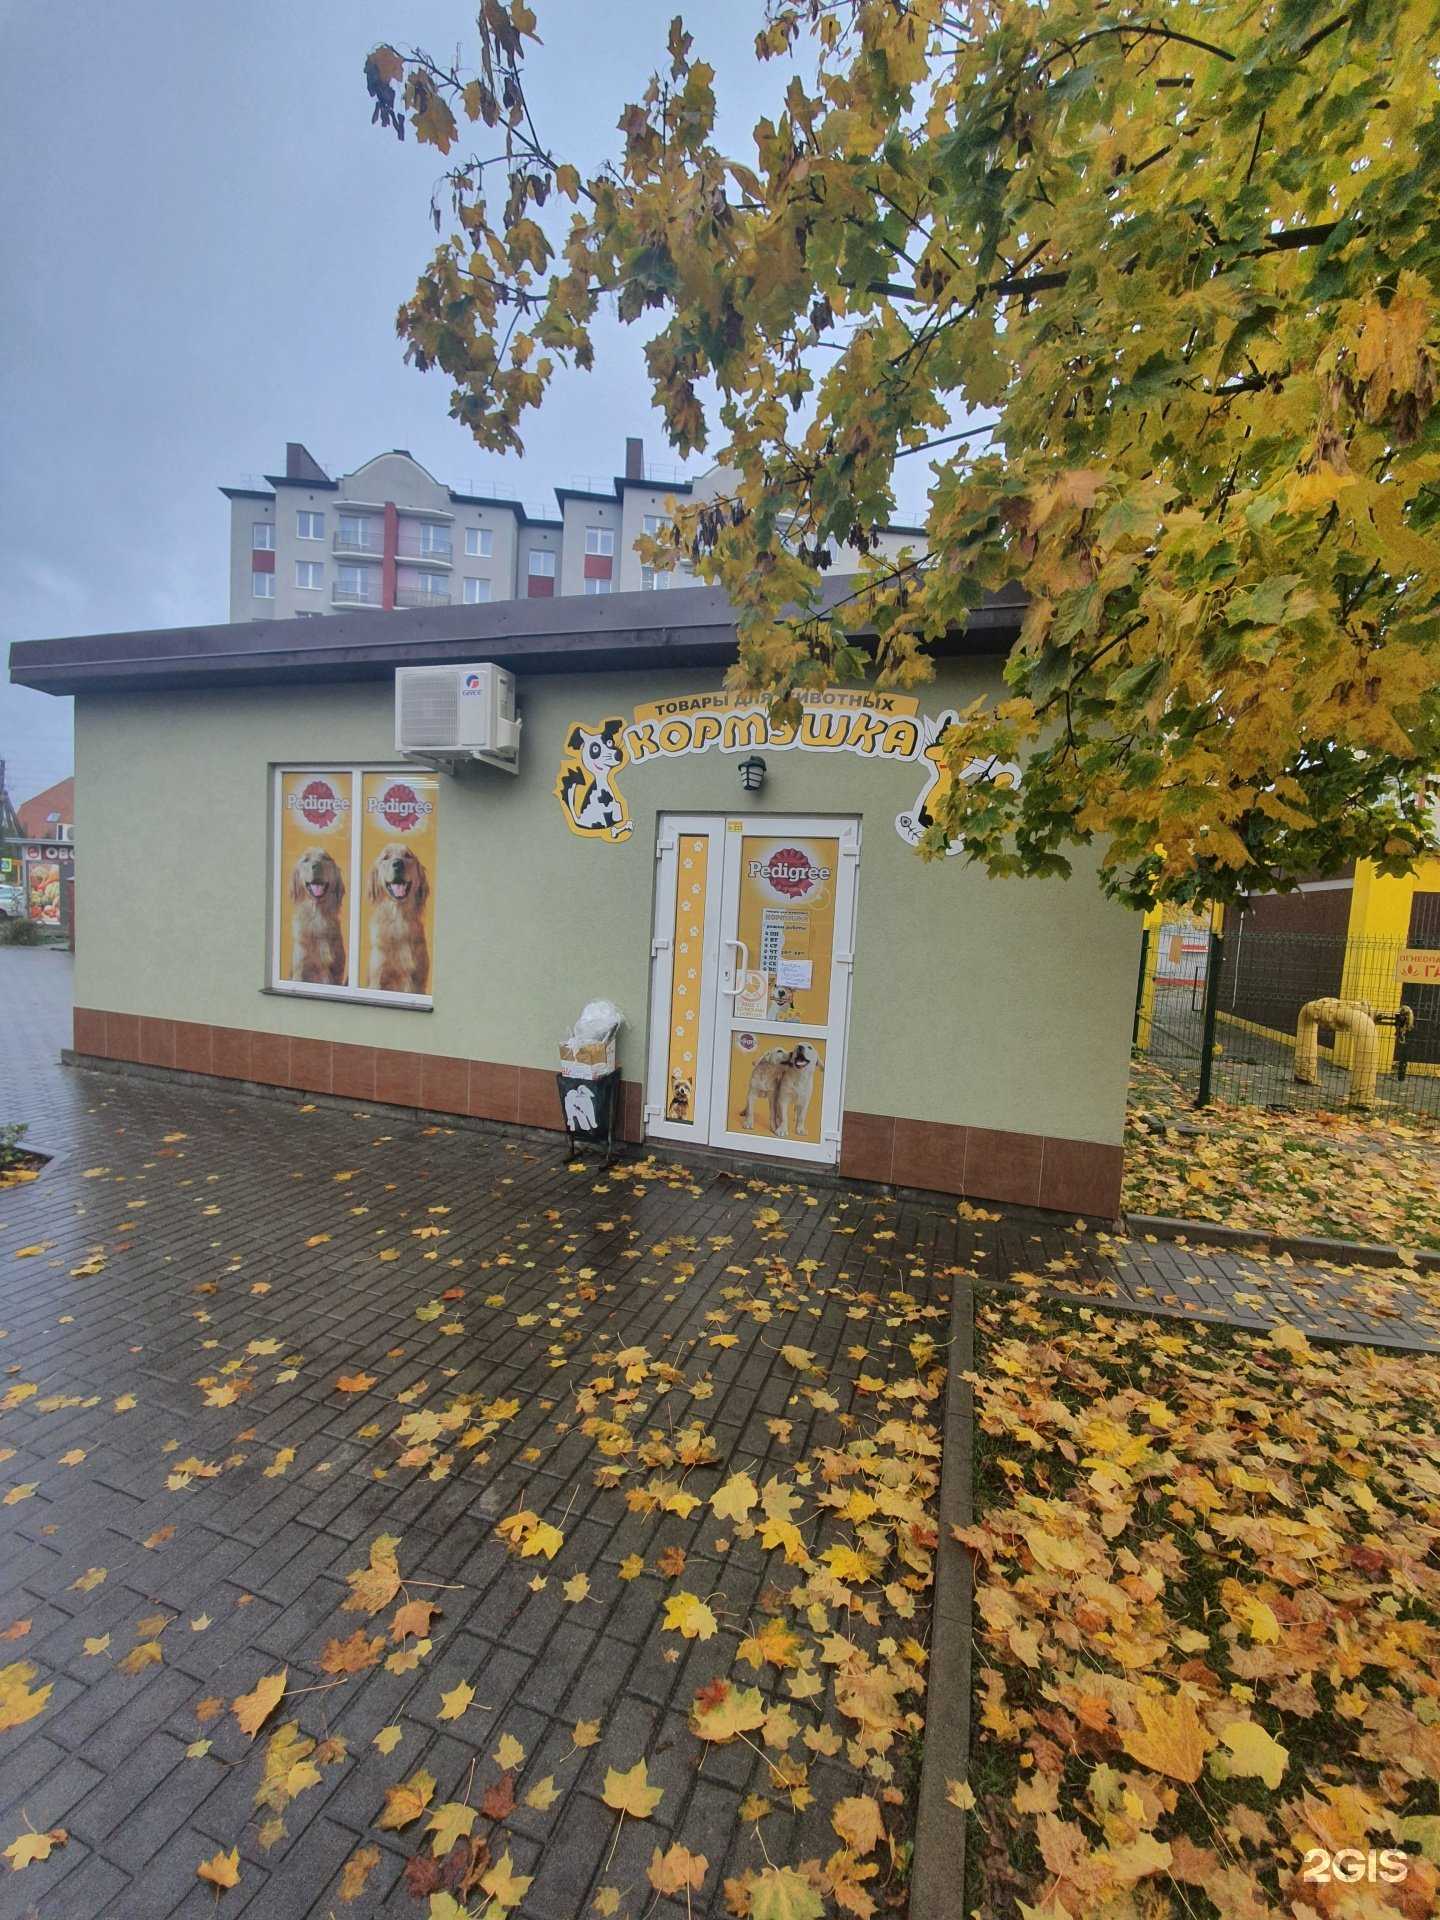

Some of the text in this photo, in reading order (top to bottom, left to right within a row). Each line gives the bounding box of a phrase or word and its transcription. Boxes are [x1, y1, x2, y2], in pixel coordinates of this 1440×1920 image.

[655, 695, 729, 716] ТОВАРЫ
[789, 691, 895, 712] ИВОТНЫХ
[287, 794, 351, 813] Pedigree
[367, 797, 433, 817] Pedigree
[748, 860, 831, 883] Pedigree
